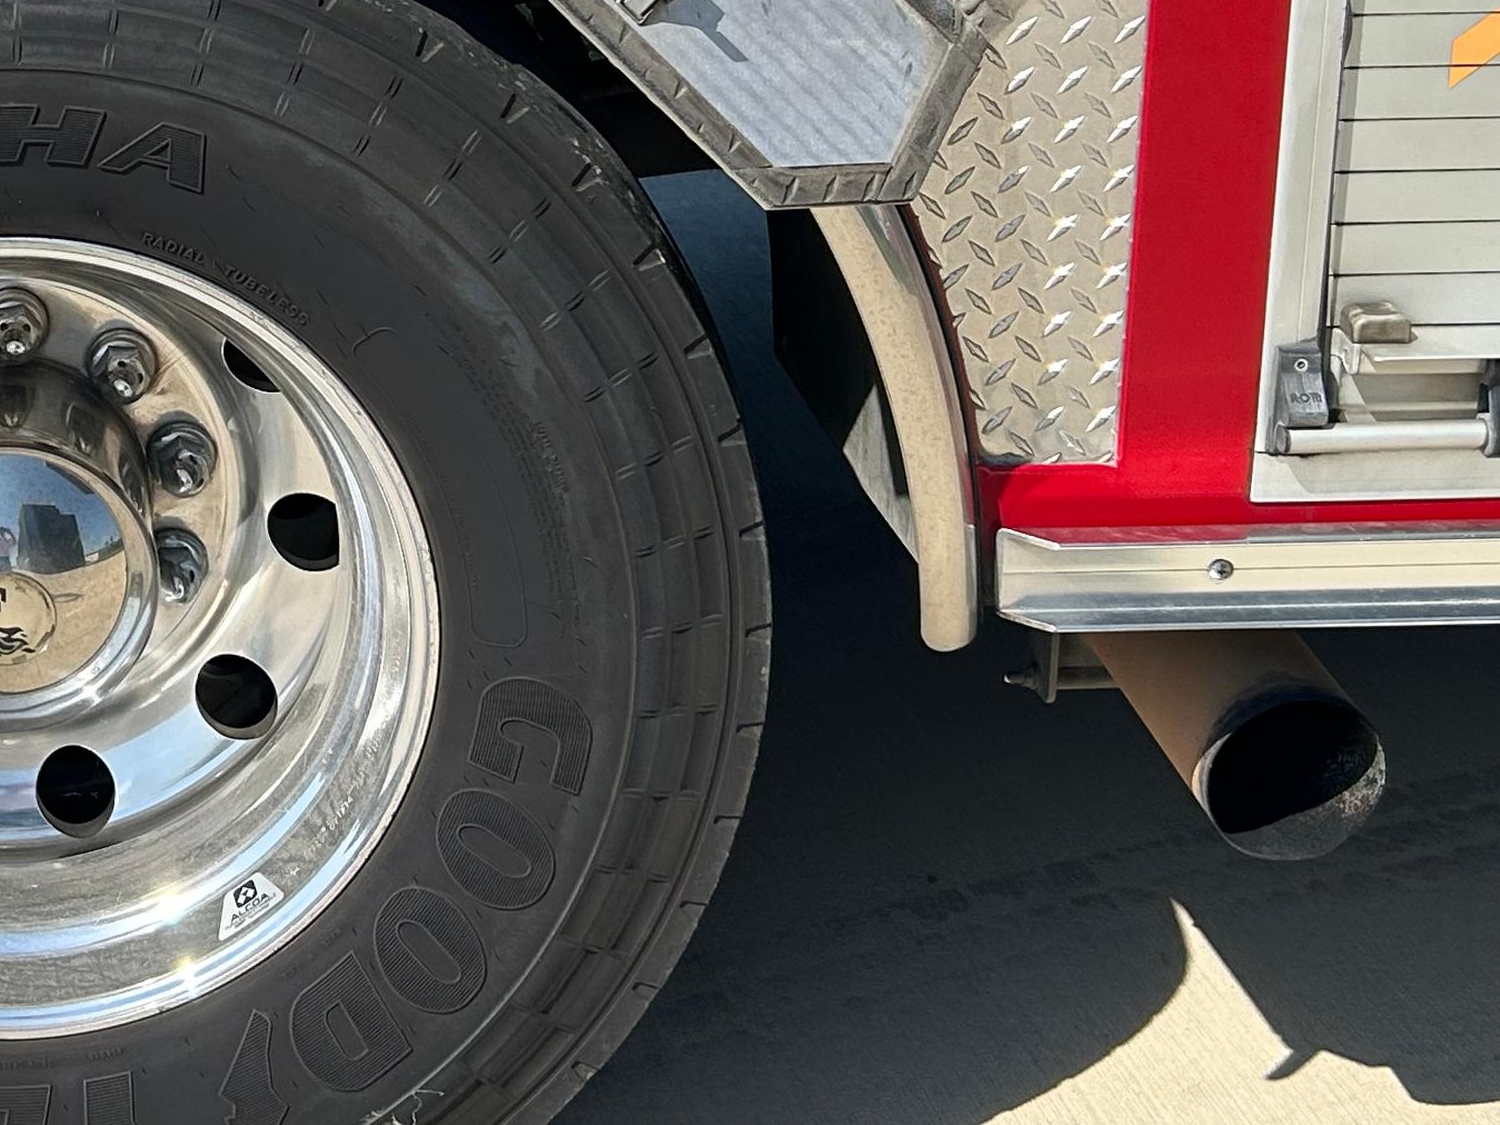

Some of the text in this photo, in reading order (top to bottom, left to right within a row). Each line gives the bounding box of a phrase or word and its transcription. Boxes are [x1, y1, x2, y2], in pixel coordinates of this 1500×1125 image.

[141, 231, 311, 327] RADIAL TUBELESS
[230, 893, 269, 923] ALCOA
